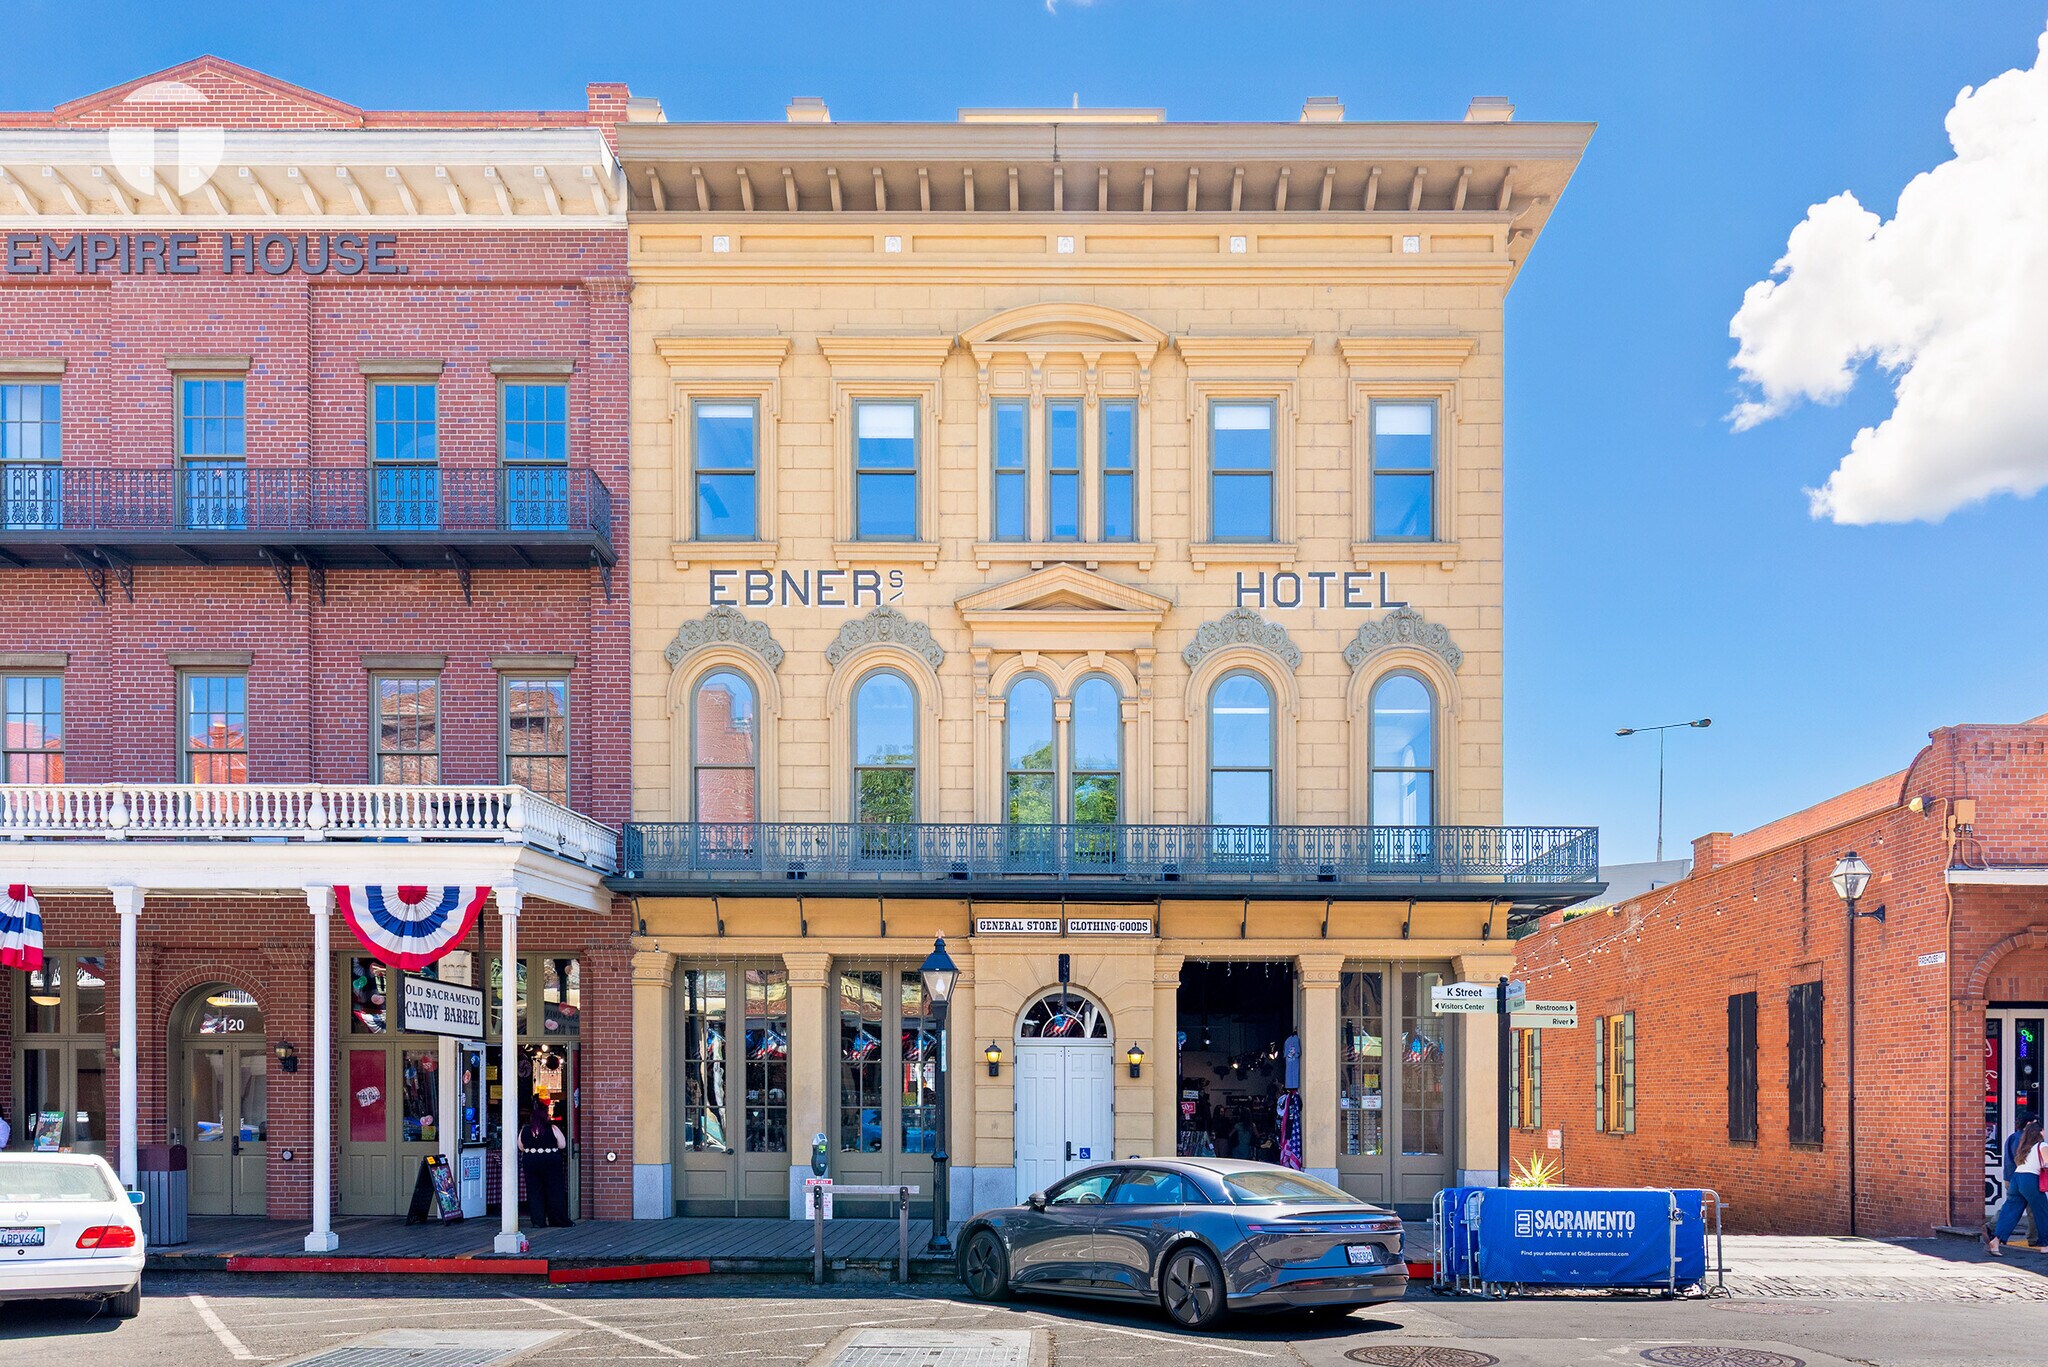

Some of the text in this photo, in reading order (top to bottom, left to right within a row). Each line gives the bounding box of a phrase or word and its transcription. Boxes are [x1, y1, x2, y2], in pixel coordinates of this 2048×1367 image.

[5, 233, 409, 275] EMPIRE HOUSE.
[1236, 571, 1411, 610] HOTEL
[979, 920, 1059, 931] GENERAL STORE
[405, 984, 480, 1007] OLD SACRAMENTO
[1446, 986, 1483, 997] K Street
[1440, 1001, 1485, 1011] Visitors Center
[1535, 1004, 1569, 1012] Restrooms
[405, 1000, 480, 1026] CANDY BARREL
[222, 1019, 245, 1031] 120
[1517, 1210, 1635, 1234] OLD SACRAMENTO
[1535, 1231, 1633, 1239] WATERFRONT
